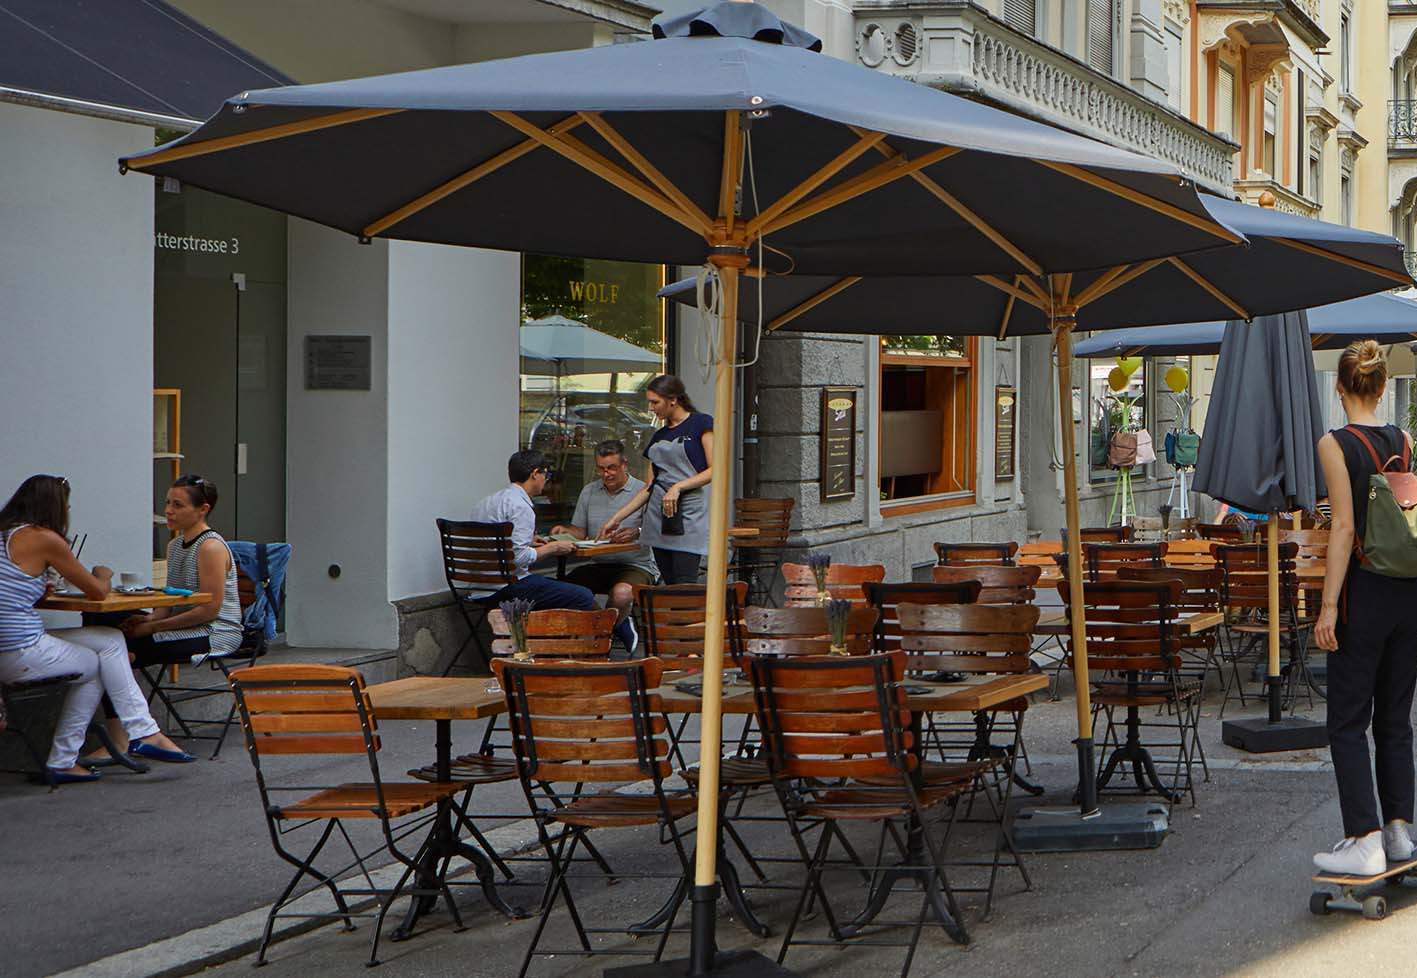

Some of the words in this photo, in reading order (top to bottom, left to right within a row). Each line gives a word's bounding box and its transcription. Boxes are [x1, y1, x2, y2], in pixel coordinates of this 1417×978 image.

[155, 232, 228, 253] tterstrasse
[231, 238, 239, 254] 3
[568, 280, 620, 305] WOLF
